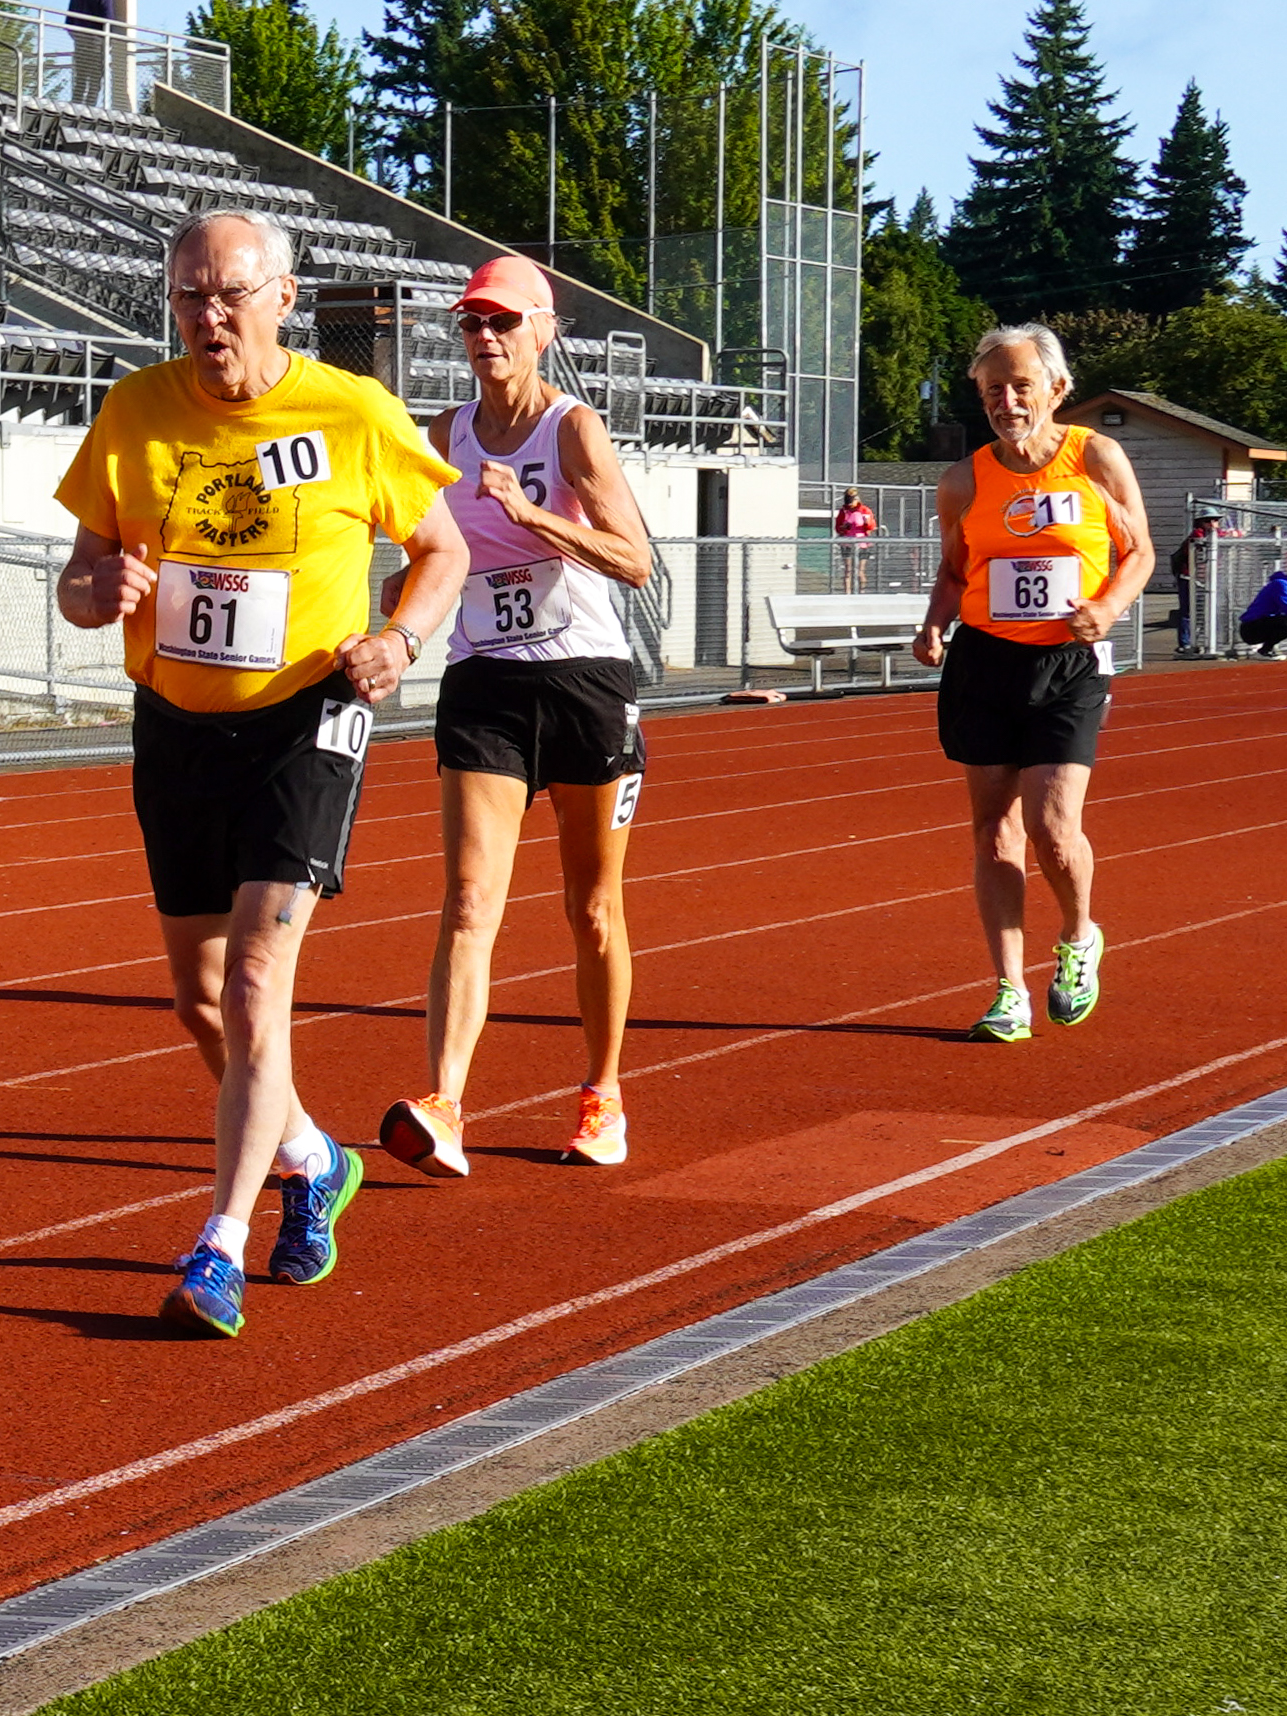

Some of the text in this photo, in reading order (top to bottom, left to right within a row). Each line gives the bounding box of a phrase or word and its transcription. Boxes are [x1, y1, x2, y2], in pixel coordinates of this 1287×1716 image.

[263, 437, 319, 485] 10
[196, 473, 272, 505] PORTLAND
[519, 462, 547, 507] 5
[186, 506, 280, 516] TRACK FIELD
[1038, 494, 1074, 523] 11
[195, 516, 269, 547] MASTERS
[214, 573, 249, 592] WSSG
[504, 568, 533, 585] WSSG
[1015, 575, 1048, 609] 63
[189, 595, 237, 647] 61
[494, 588, 534, 633] 53
[158, 642, 276, 665] Washington State Senior Games
[326, 703, 366, 755] 10
[617, 779, 639, 824] 5
